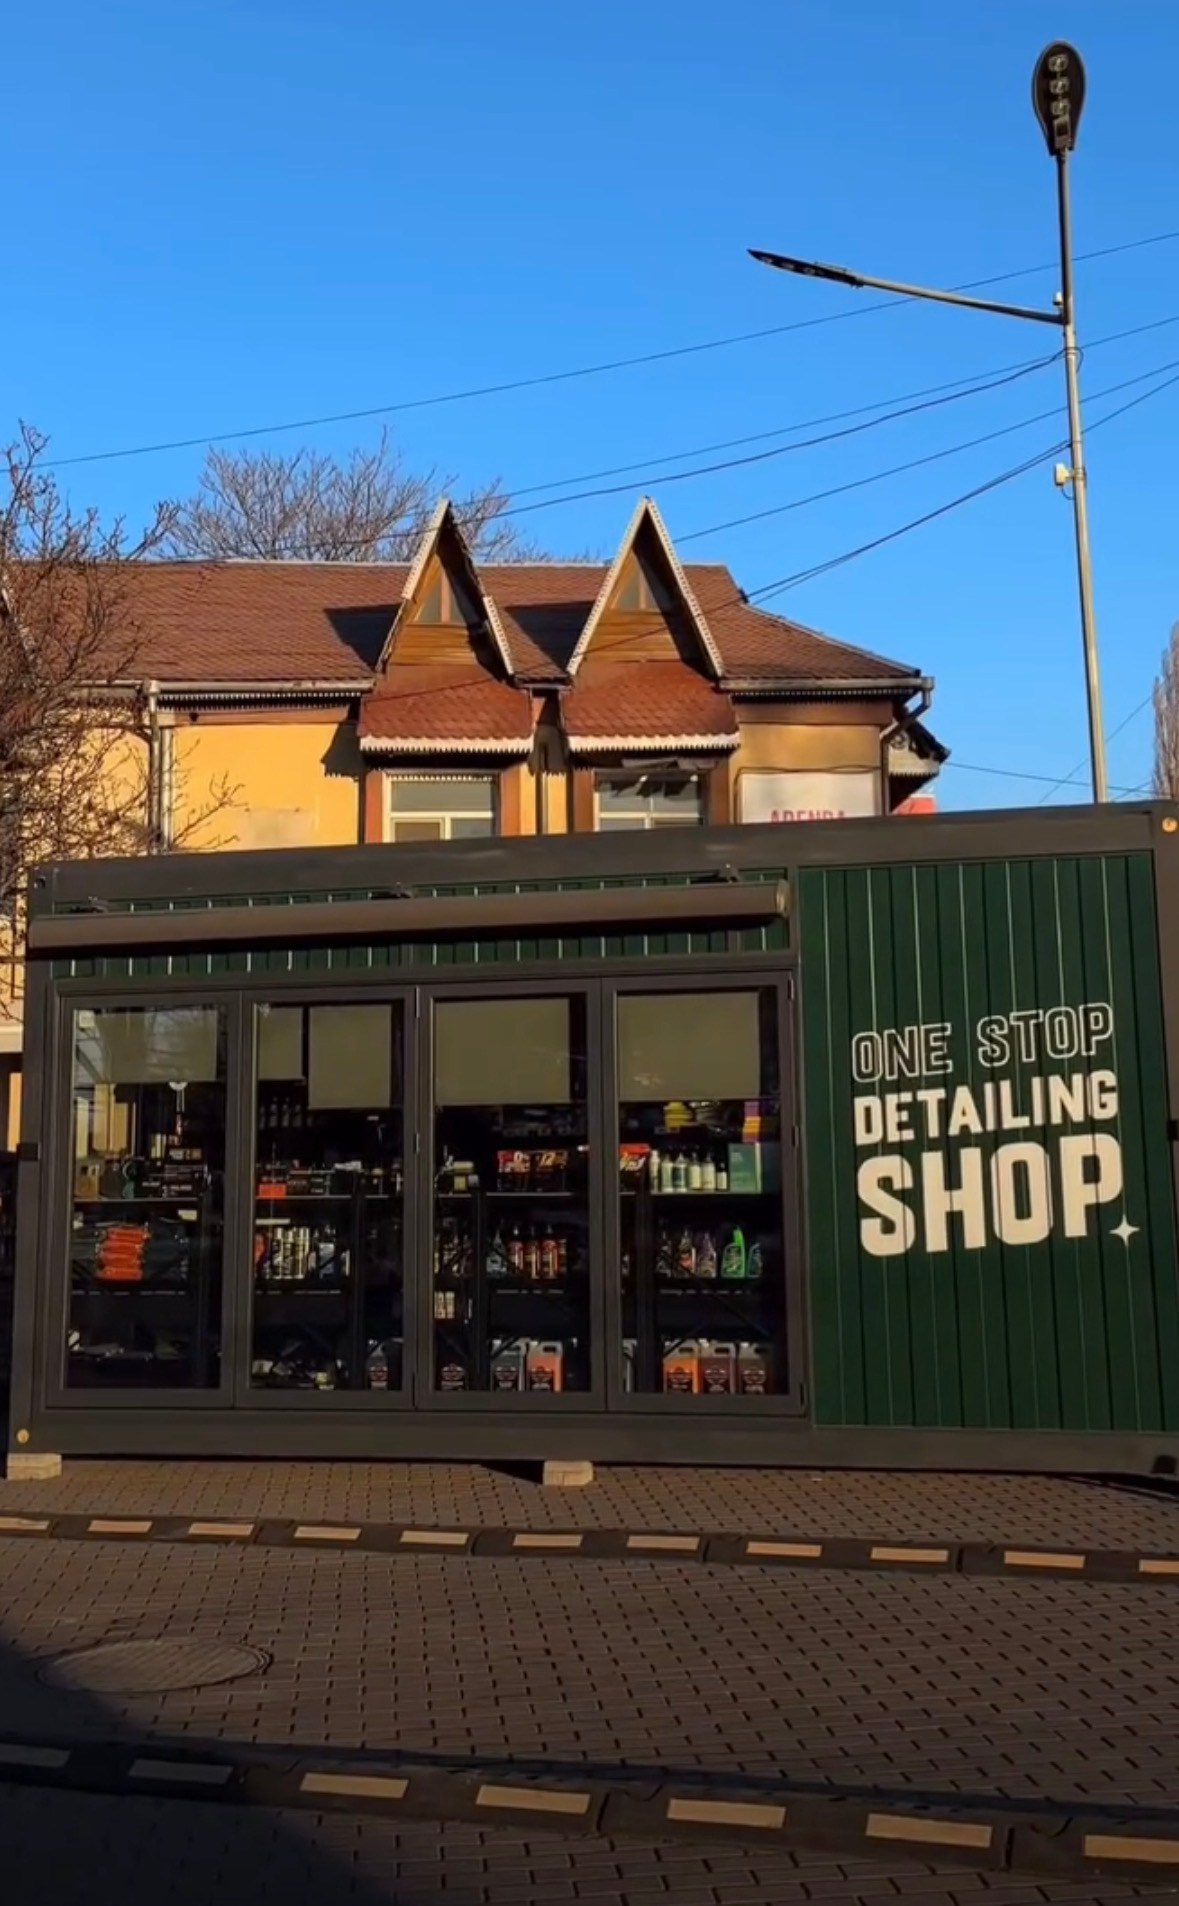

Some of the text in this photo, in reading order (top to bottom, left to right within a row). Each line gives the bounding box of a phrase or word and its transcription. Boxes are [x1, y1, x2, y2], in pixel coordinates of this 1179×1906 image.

[851, 1002, 1115, 1084] ONE STOP
[853, 1070, 1119, 1146] DETAILING
[857, 1133, 1123, 1258] SHOP
